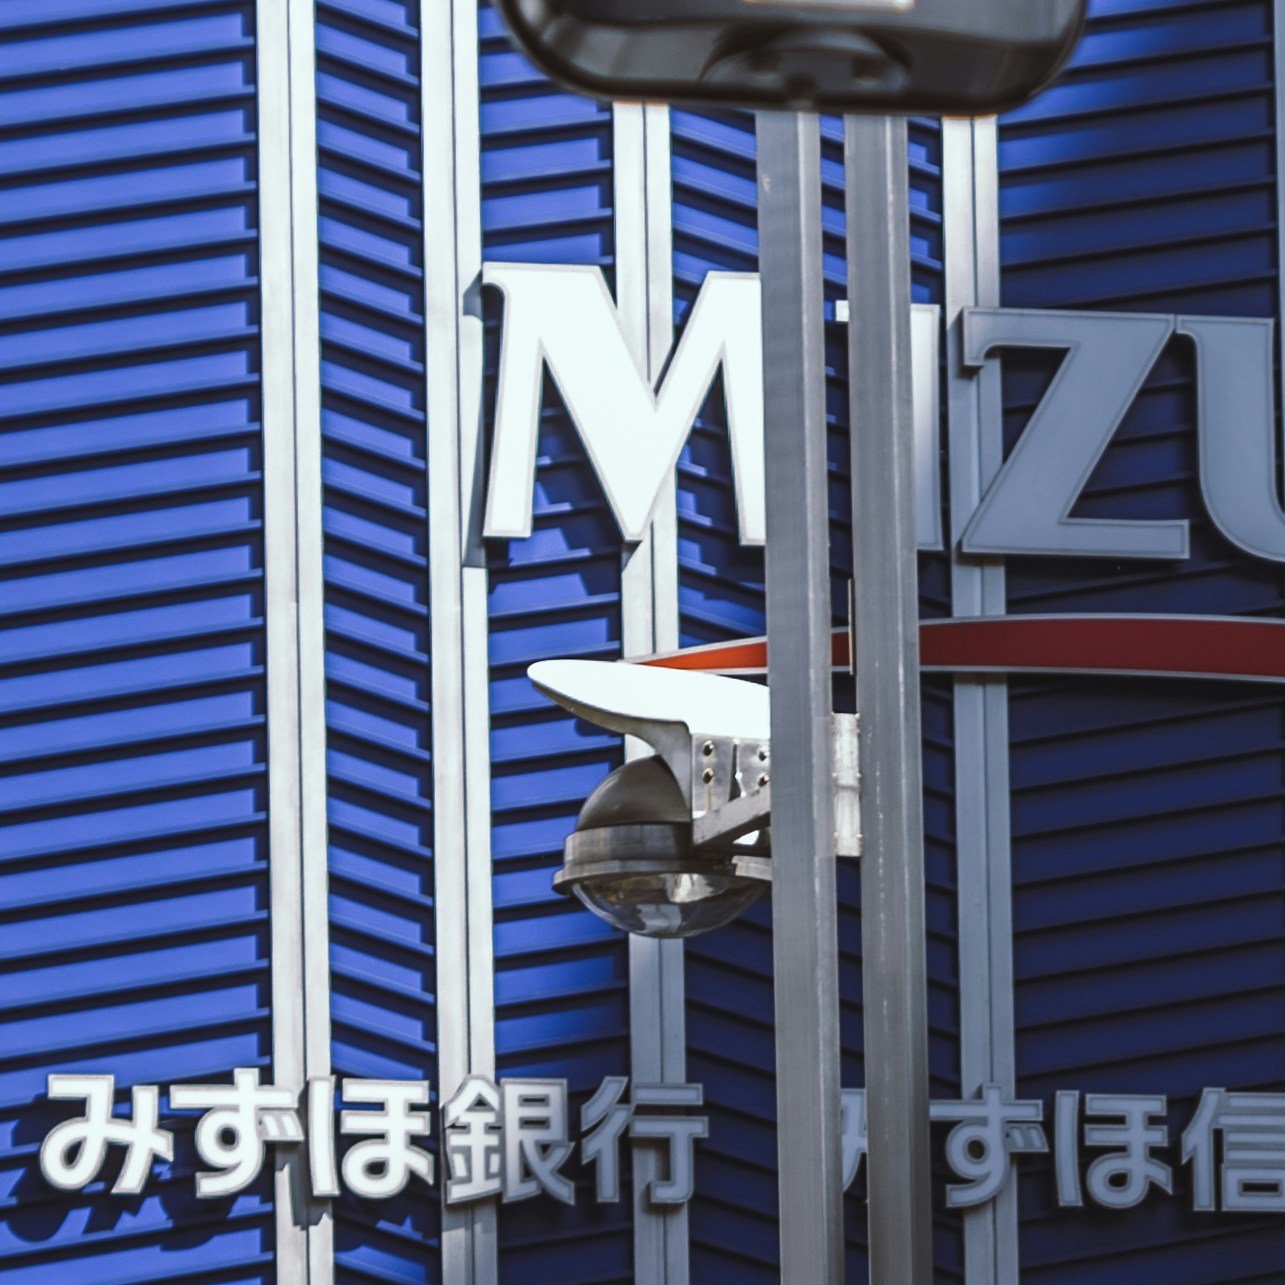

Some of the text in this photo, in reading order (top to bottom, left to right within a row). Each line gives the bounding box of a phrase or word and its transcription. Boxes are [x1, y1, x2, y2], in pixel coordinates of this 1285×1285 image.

[39, 1068, 710, 1206] みずほ銀行
